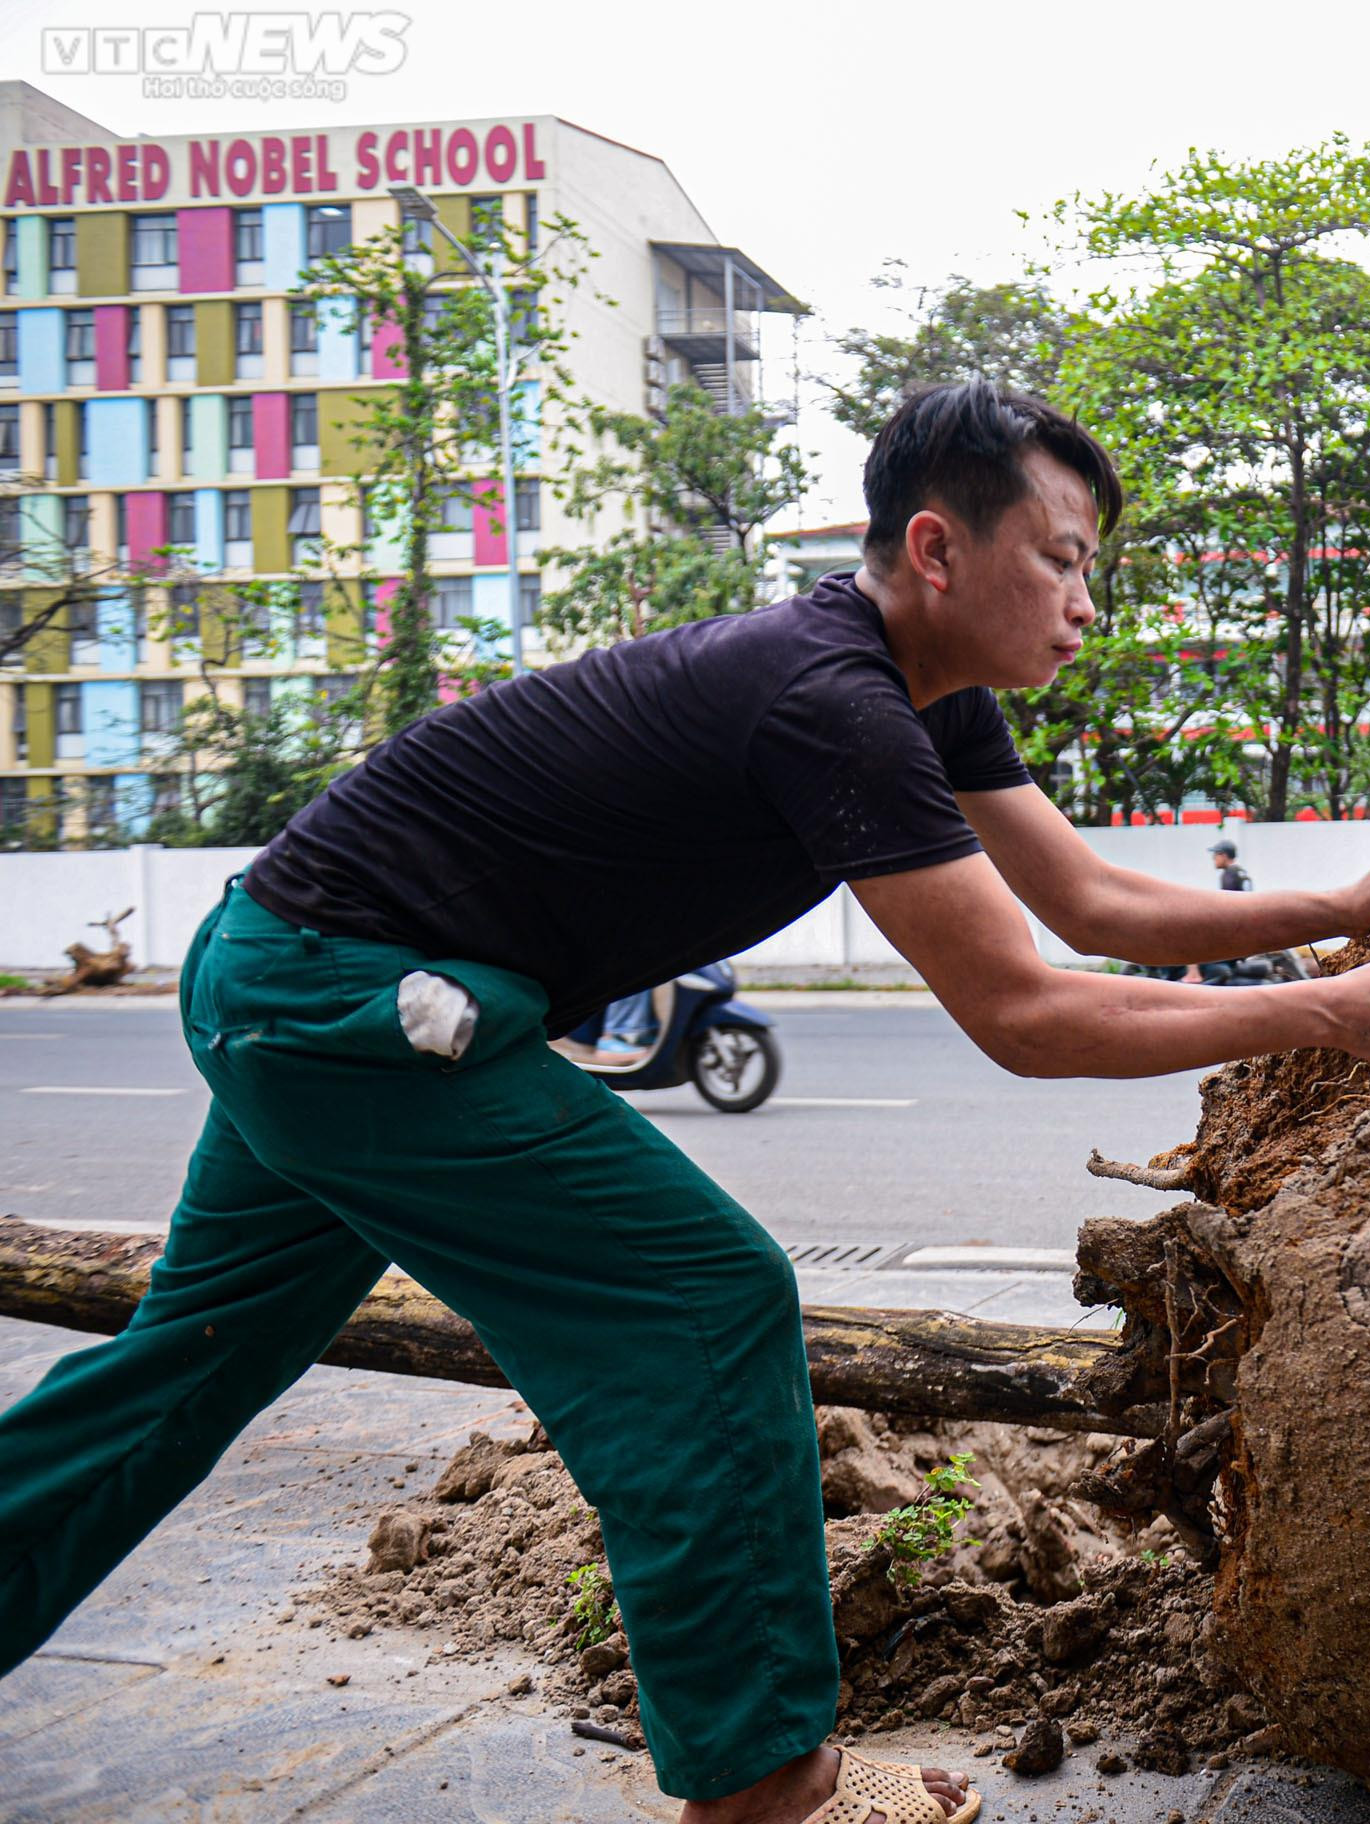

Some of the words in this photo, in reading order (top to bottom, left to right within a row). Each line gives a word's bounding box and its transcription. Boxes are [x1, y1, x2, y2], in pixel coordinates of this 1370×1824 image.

[4, 144, 170, 206] ALFRED
[188, 135, 338, 199] NOBEL
[356, 123, 546, 190] SCHOOL
